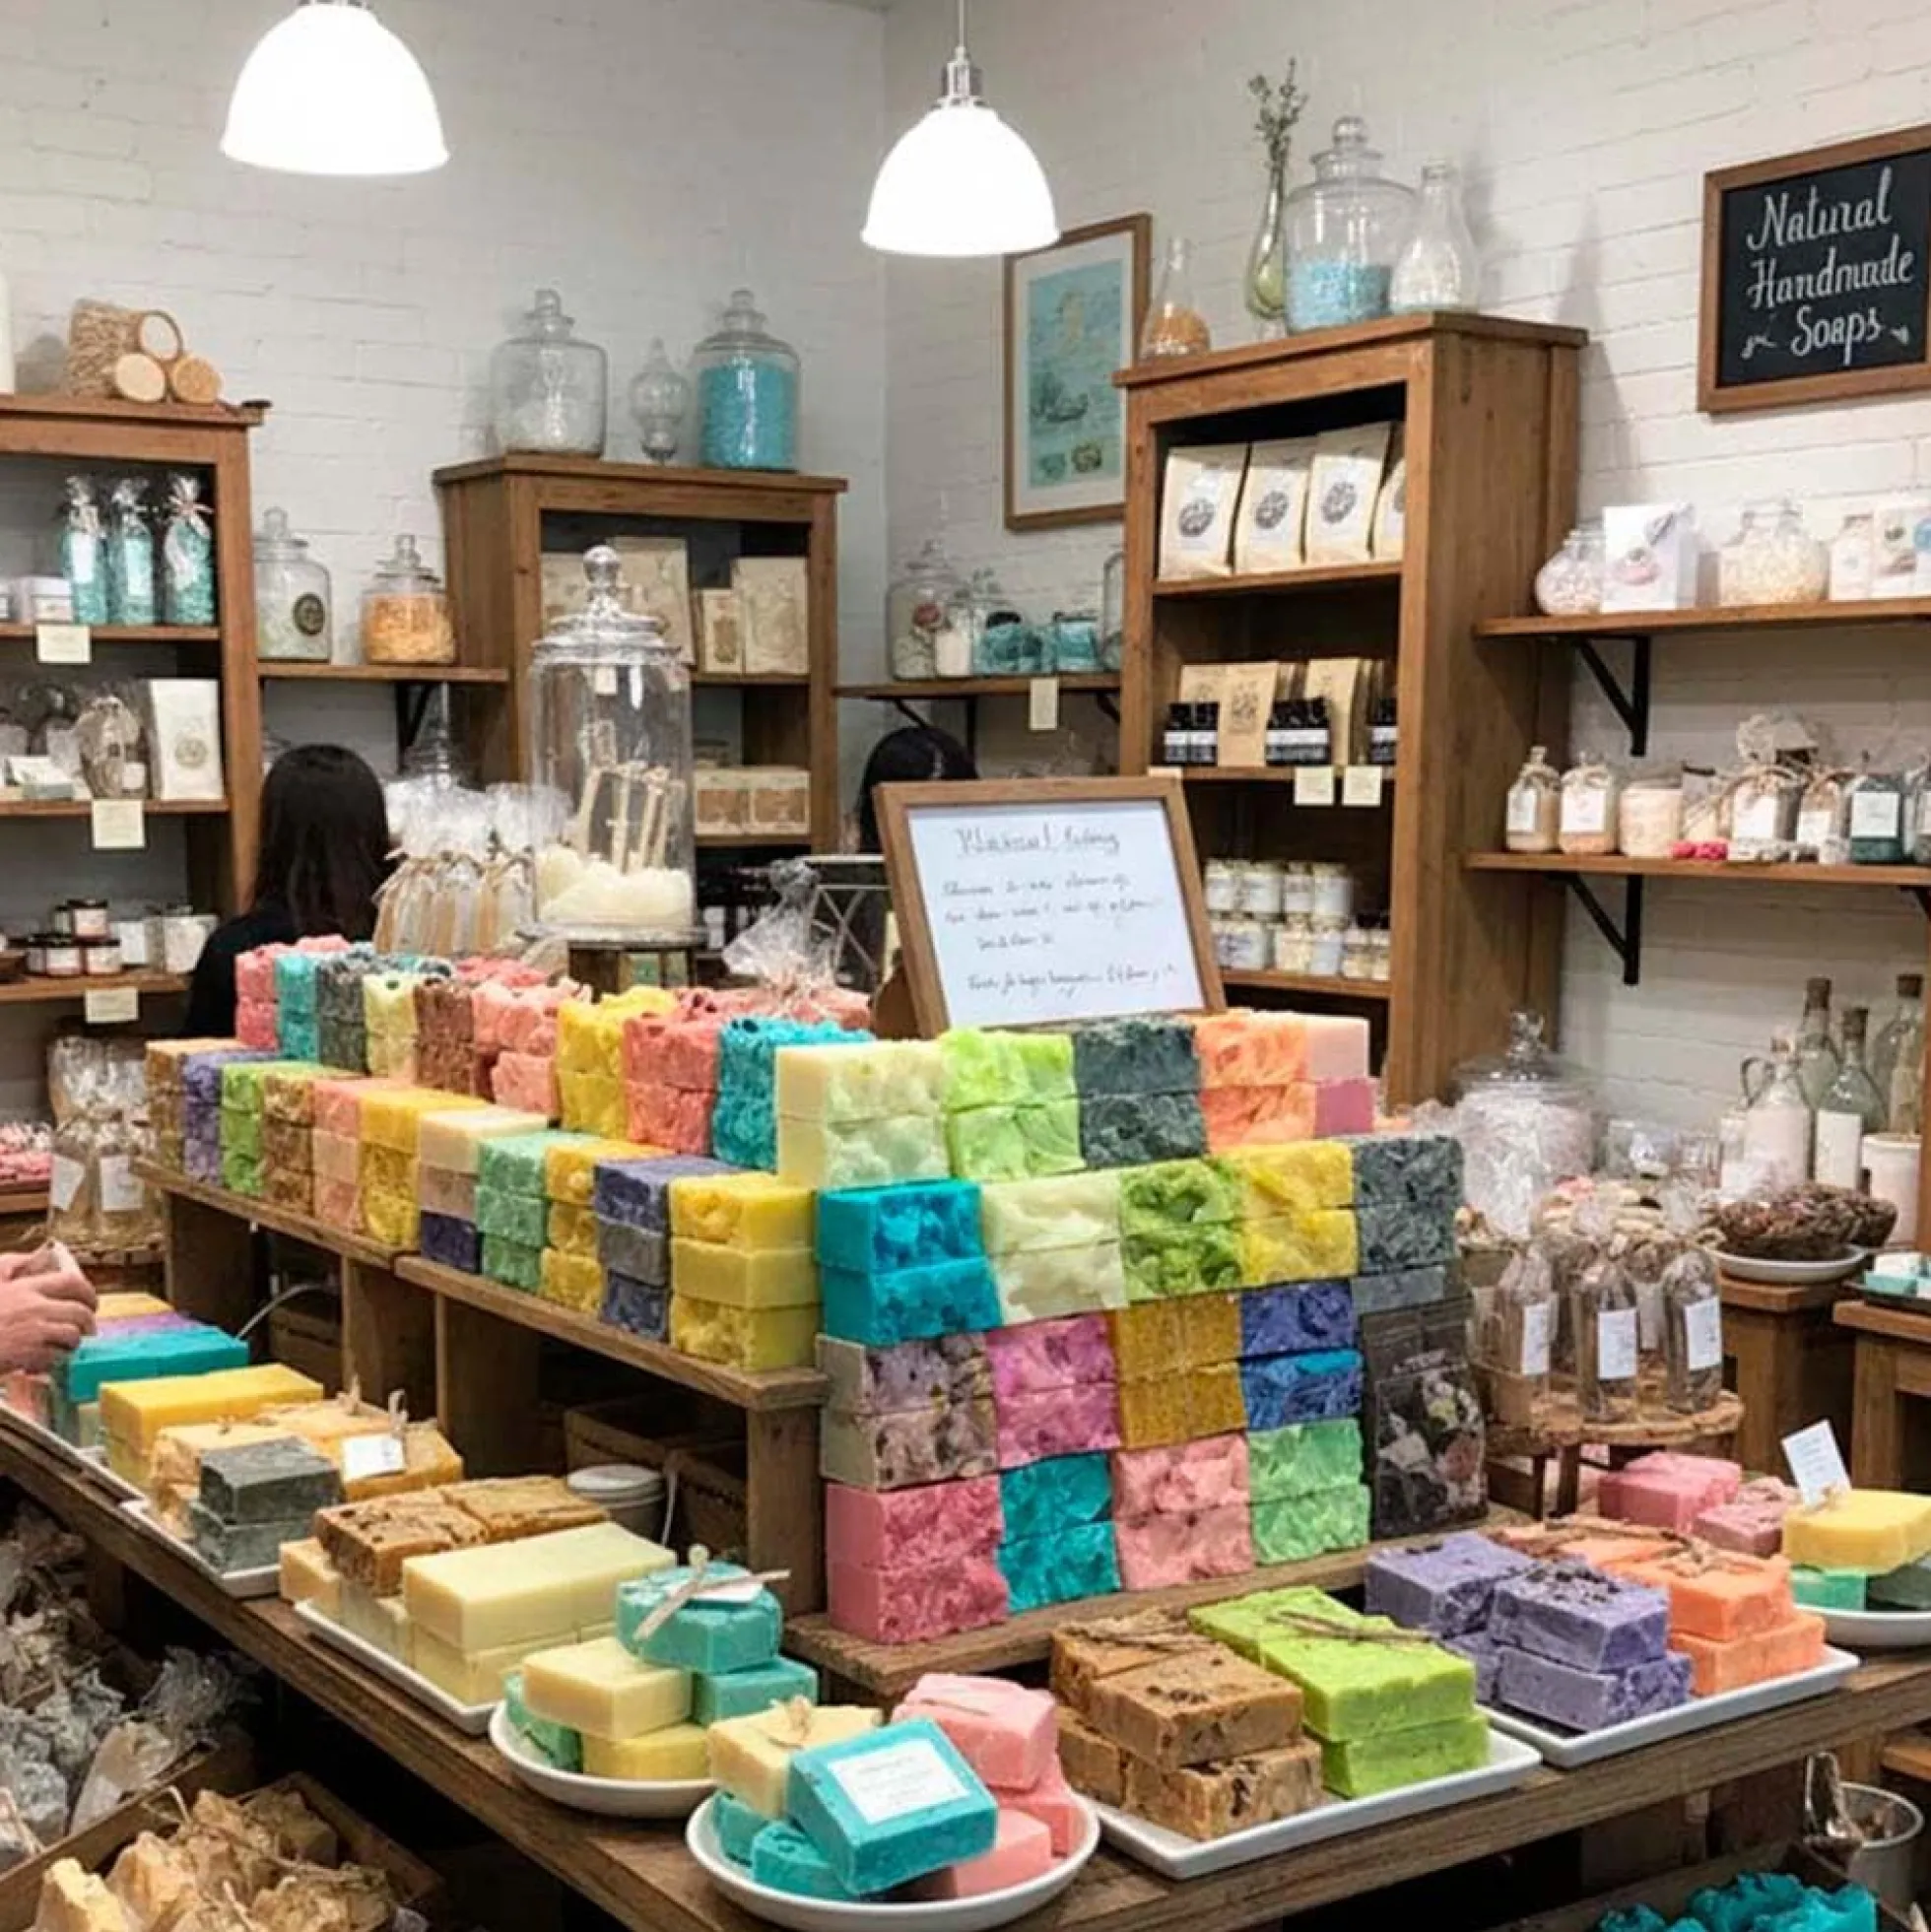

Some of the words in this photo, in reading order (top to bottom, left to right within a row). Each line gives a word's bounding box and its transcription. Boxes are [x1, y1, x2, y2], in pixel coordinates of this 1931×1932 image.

[1746, 166, 1892, 250] Natural
[1746, 233, 1914, 308] Handmade
[1790, 304, 1886, 366] Soaps
